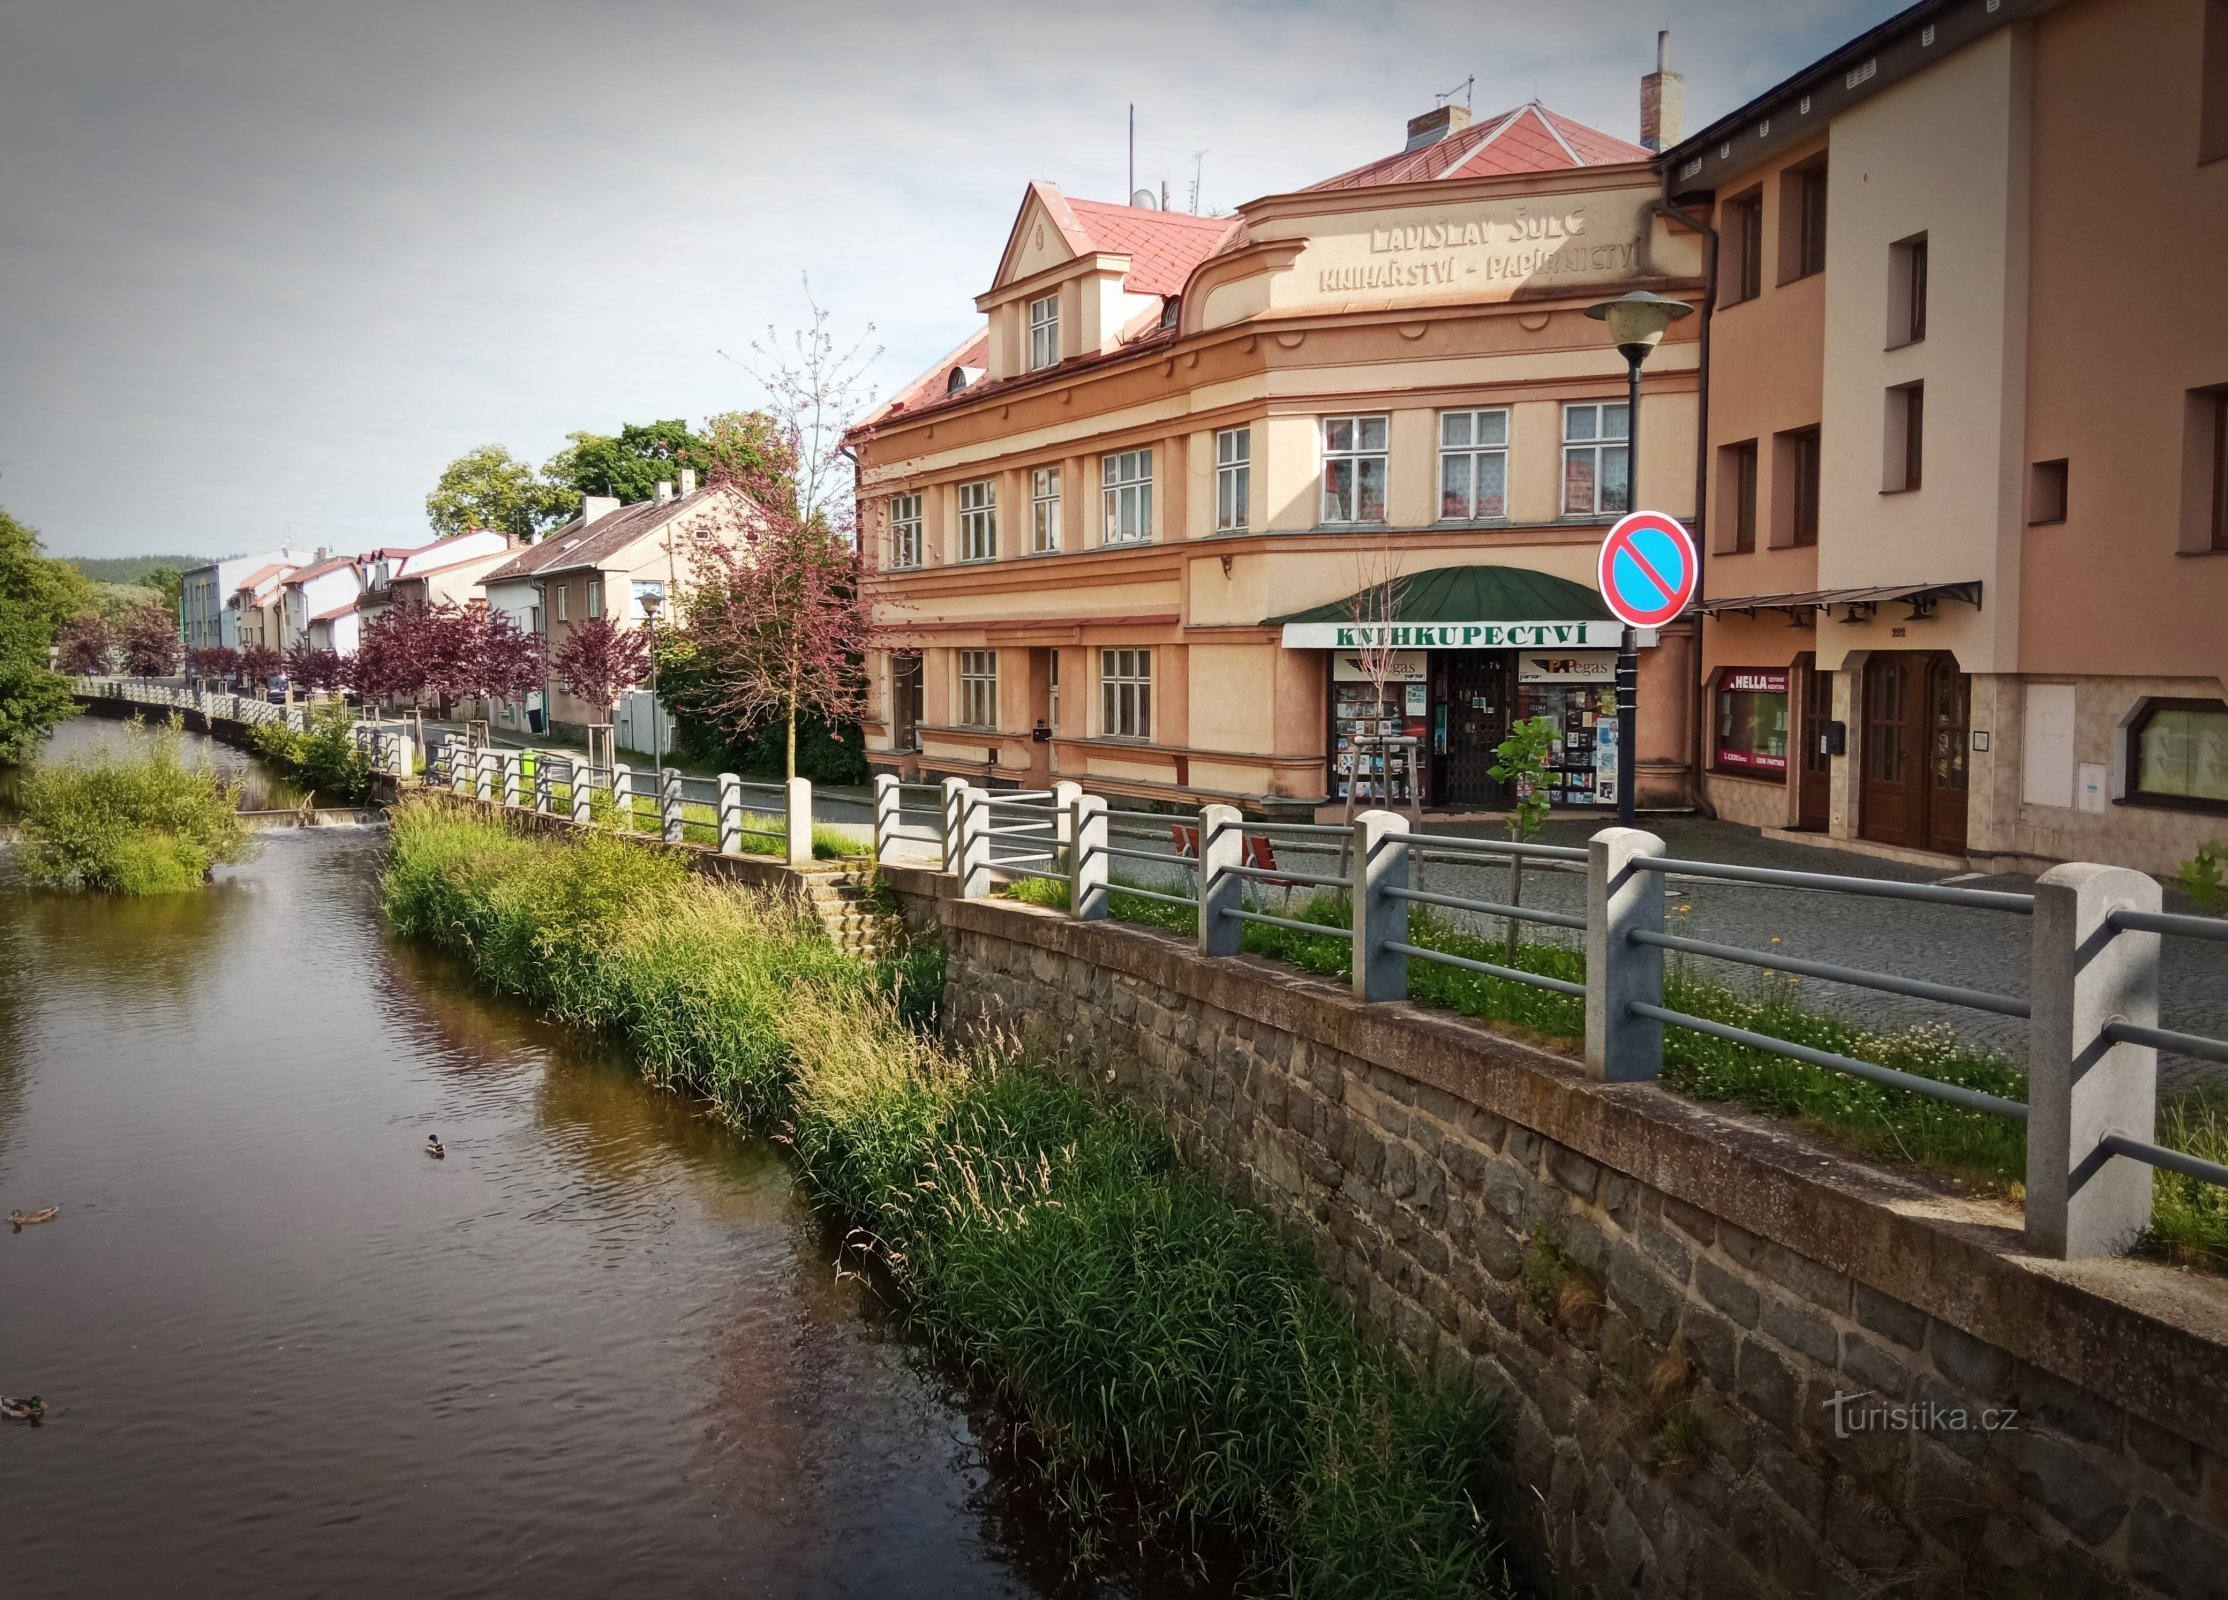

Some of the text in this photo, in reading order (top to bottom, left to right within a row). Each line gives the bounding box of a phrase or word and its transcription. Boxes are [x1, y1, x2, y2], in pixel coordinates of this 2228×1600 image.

[1370, 206, 1585, 254] LADISLAV ŠULC
[1486, 236, 1641, 281] PAPÍRNICTVÍ
[1336, 622, 1588, 646] KNIHKUPECTVÍ
[1567, 659, 1607, 676] Pegas
[1735, 675, 1767, 689] HELLA
